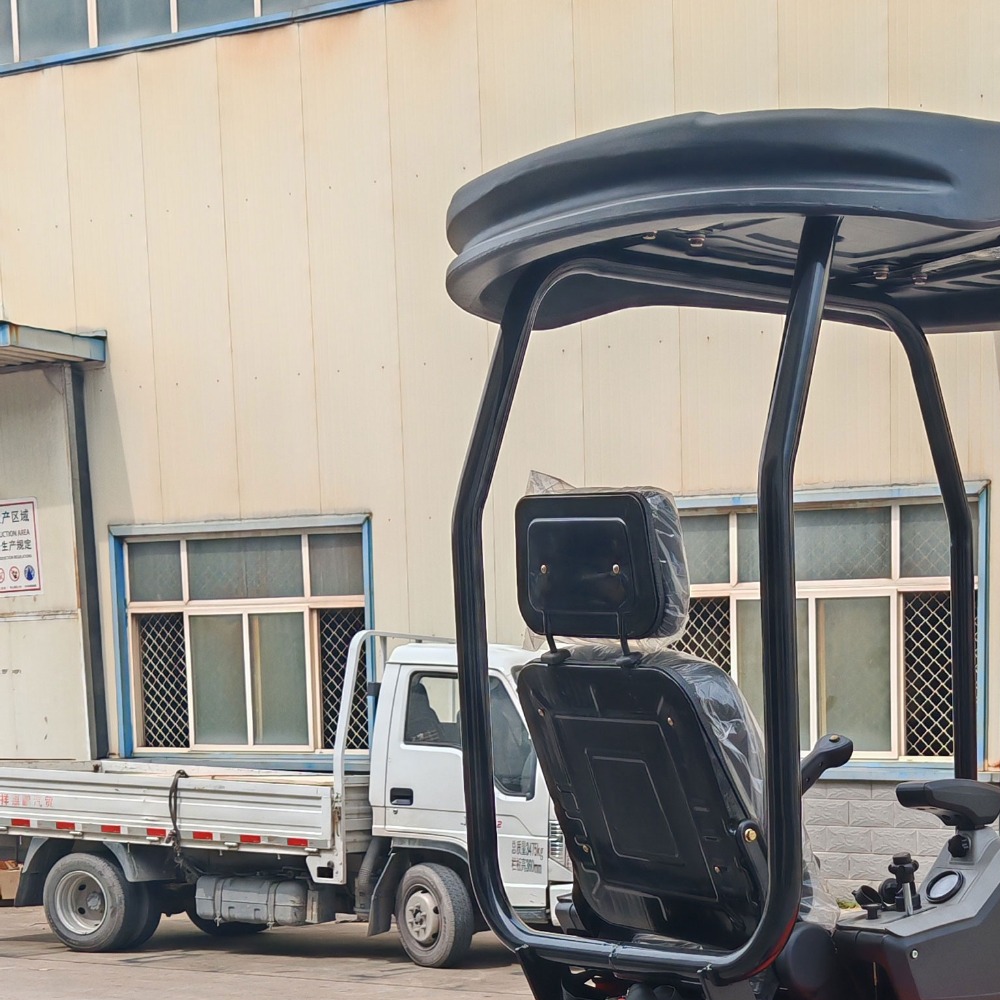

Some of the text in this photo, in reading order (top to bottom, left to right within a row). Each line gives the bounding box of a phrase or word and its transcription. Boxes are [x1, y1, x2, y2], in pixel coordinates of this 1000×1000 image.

[0, 509, 30, 524] 产区域
[0, 539, 32, 551] 生产规定
